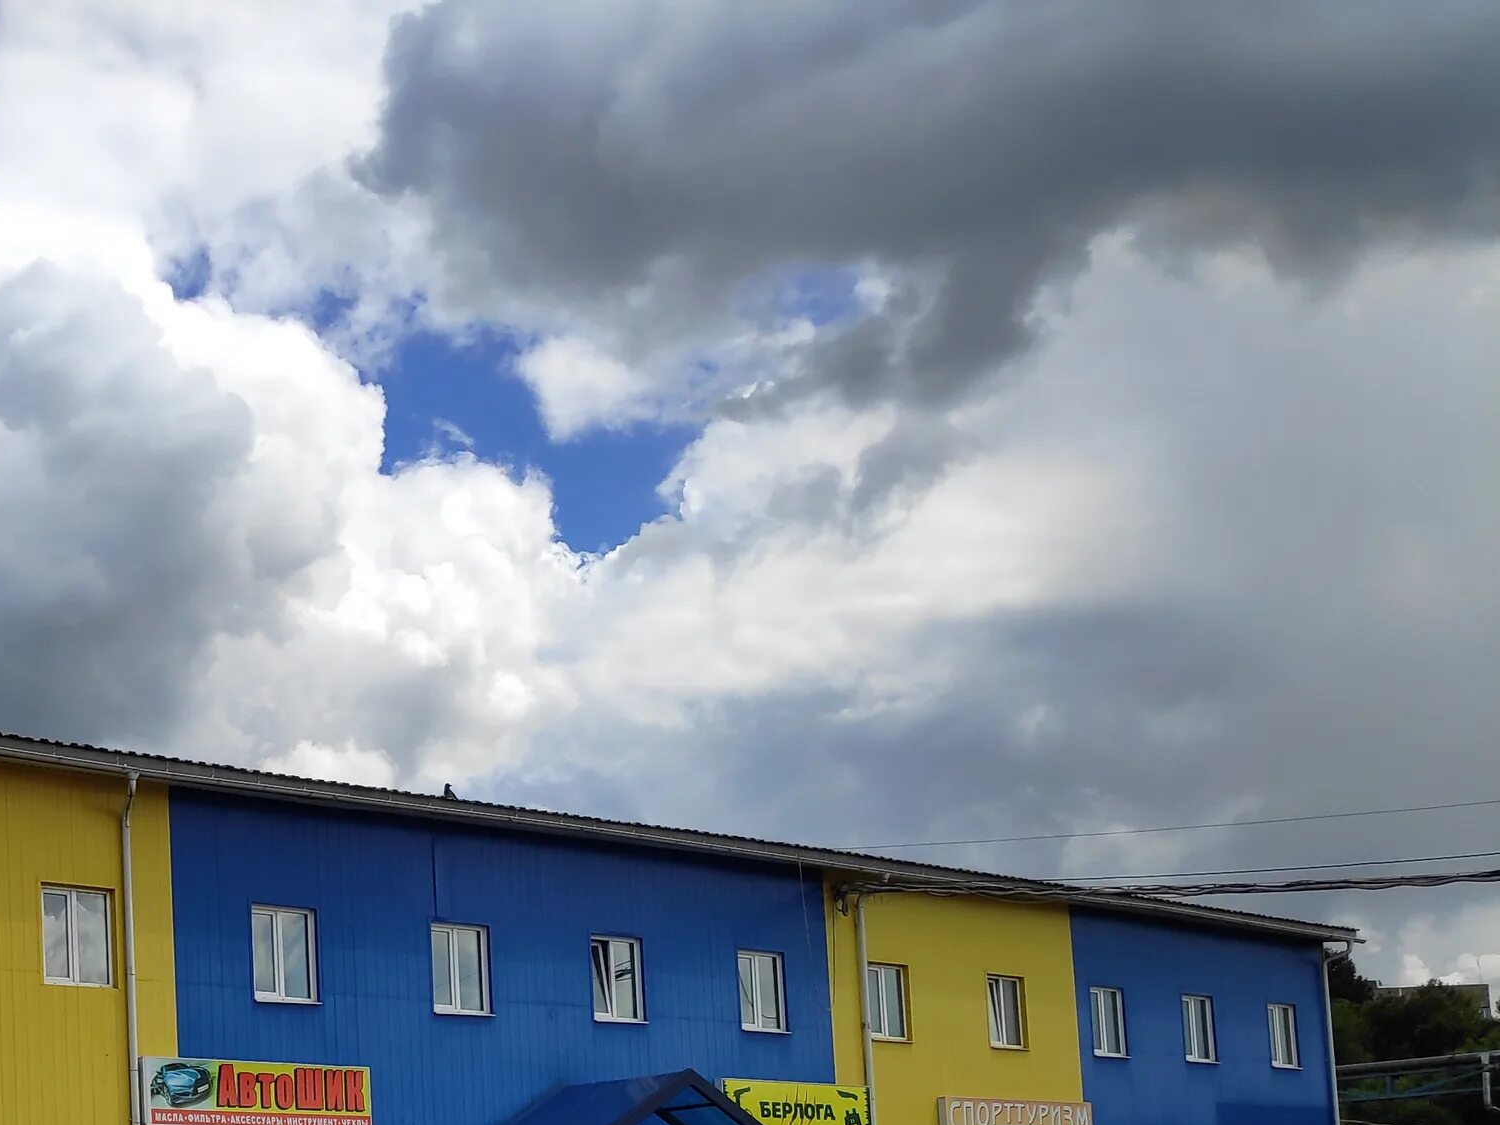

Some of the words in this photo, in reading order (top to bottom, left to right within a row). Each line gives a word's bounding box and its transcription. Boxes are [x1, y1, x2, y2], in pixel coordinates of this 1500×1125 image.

[154, 1112, 185, 1122] МАСЛА
[187, 1113, 227, 1124] ФИЛЬТРА
[230, 1115, 283, 1125] АКСЕССУАРЫ
[759, 1101, 836, 1121] БЕРЛОГА
